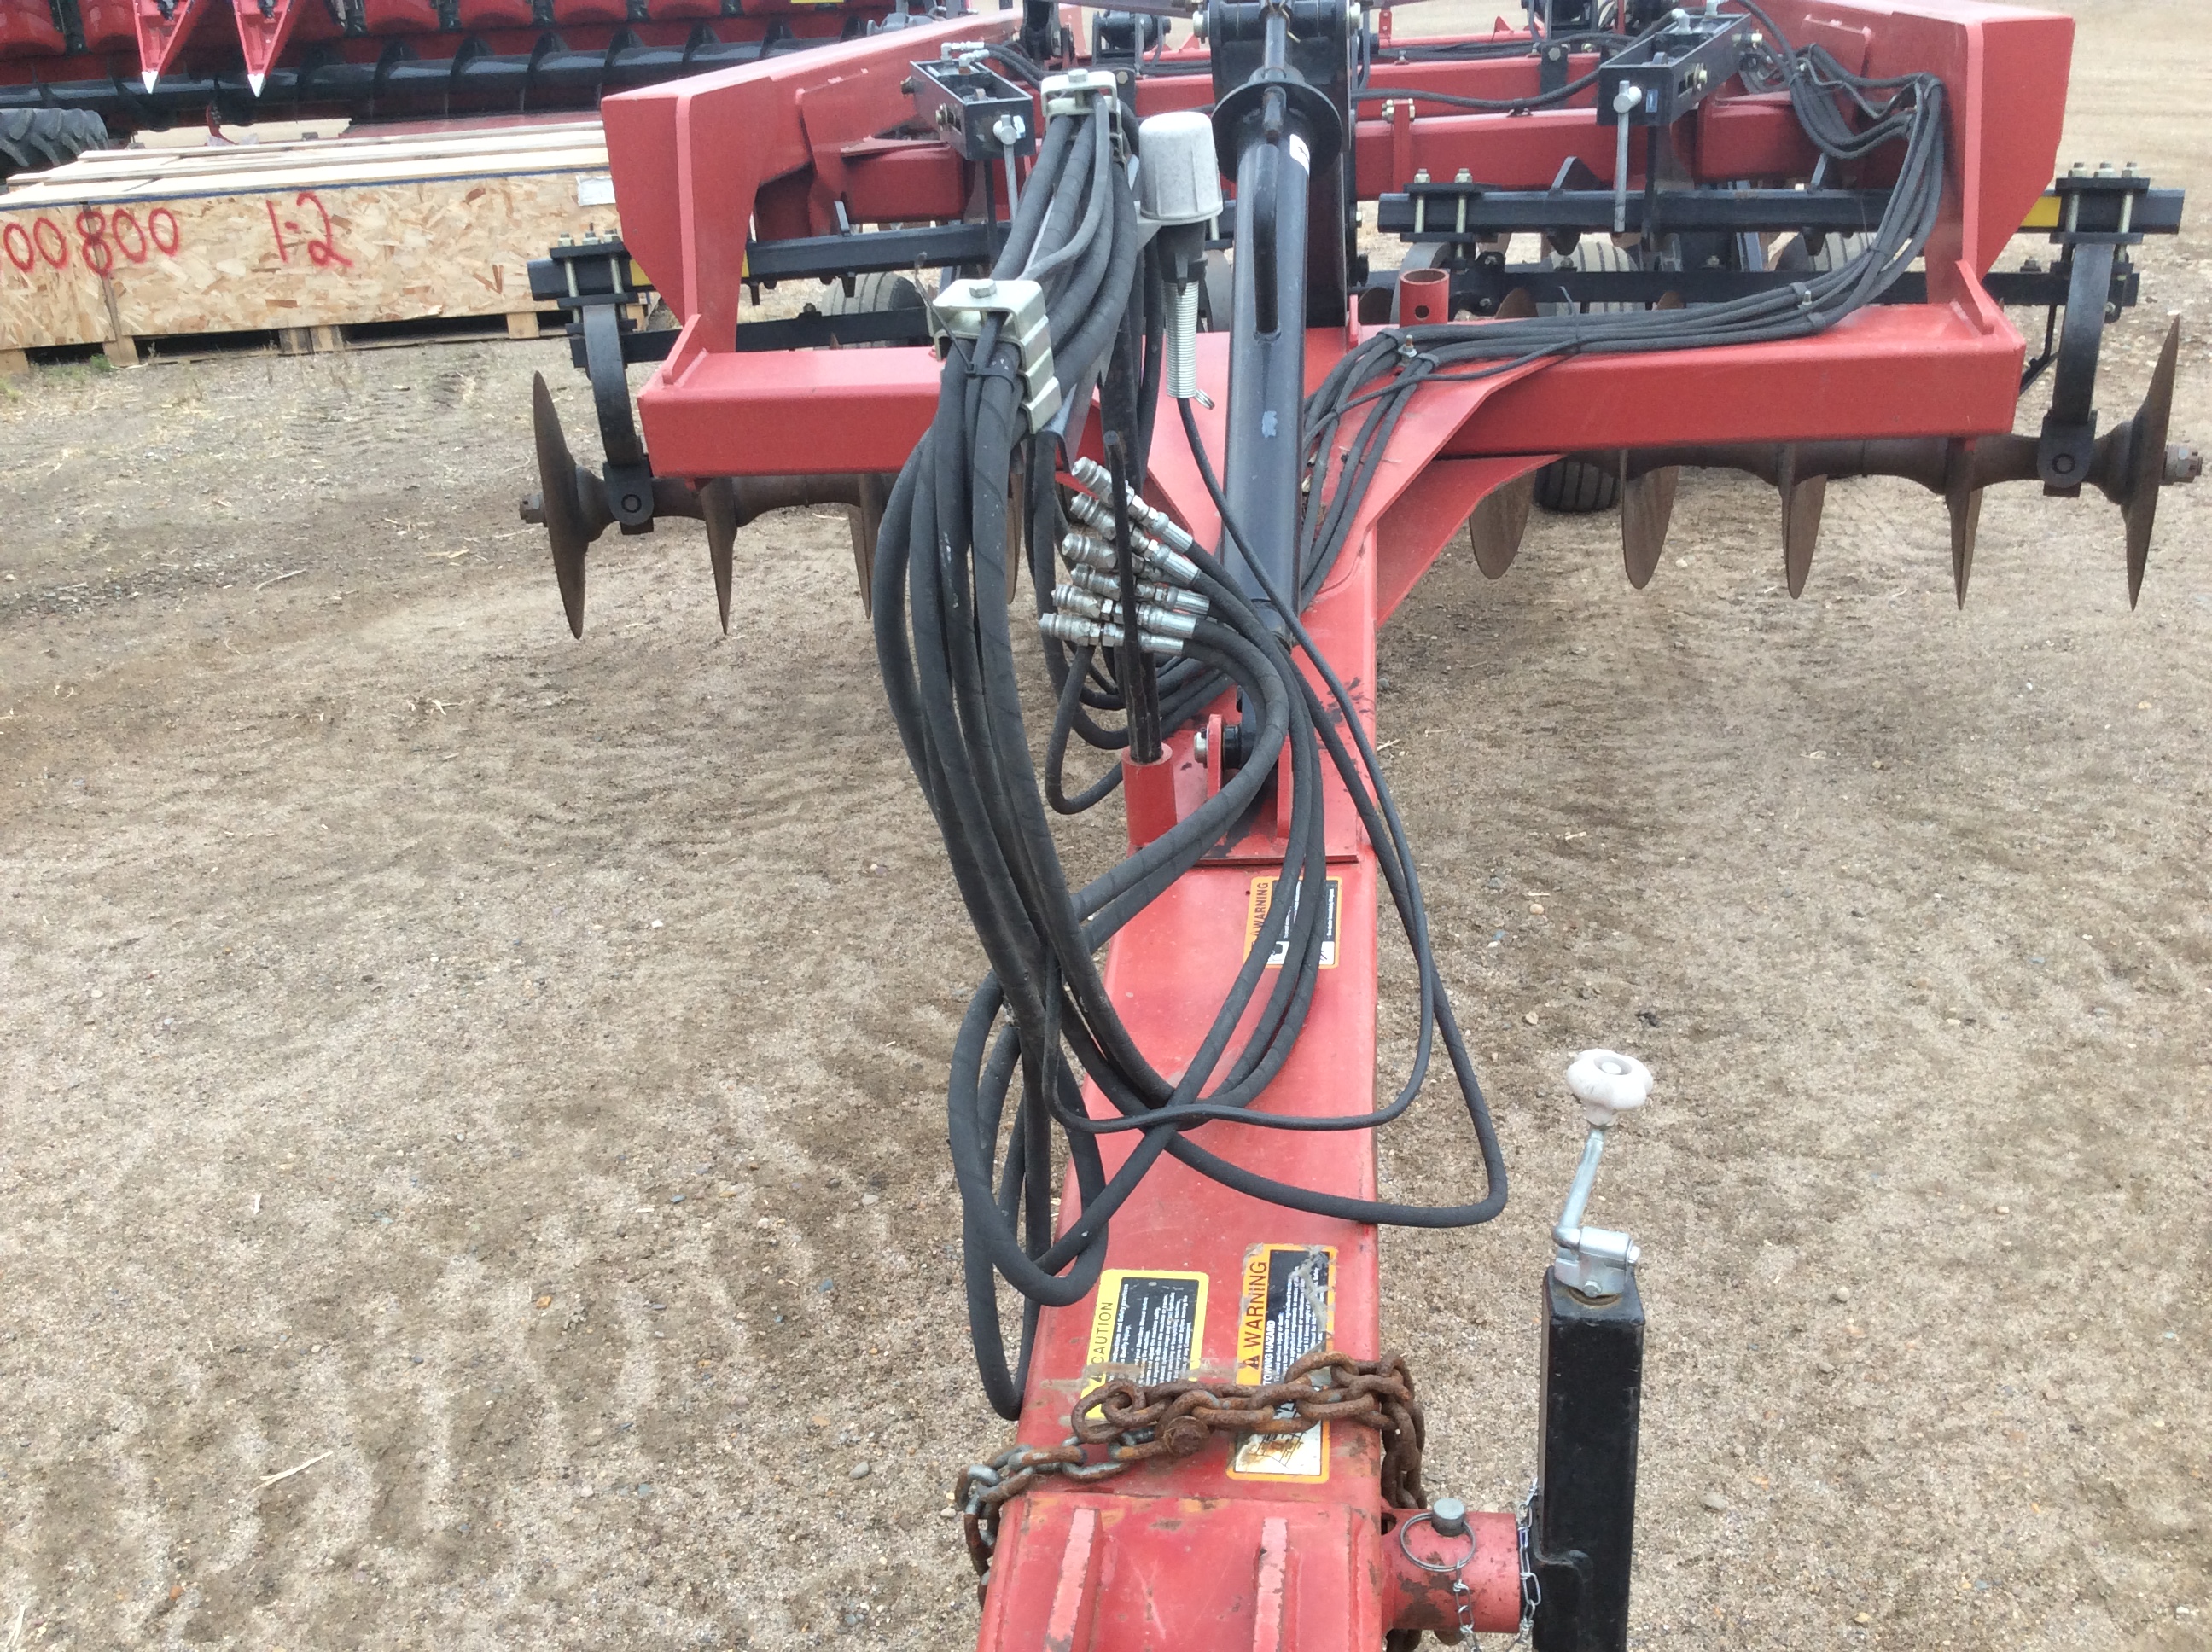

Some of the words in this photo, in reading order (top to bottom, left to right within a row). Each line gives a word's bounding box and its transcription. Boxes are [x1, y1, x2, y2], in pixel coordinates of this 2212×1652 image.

[1243, 1261, 1266, 1347] WARNING
[1091, 1302, 1113, 1363] CAUTION
[1265, 1320, 1275, 1352] HAZARD
[1262, 1353, 1273, 1385] TOWING
